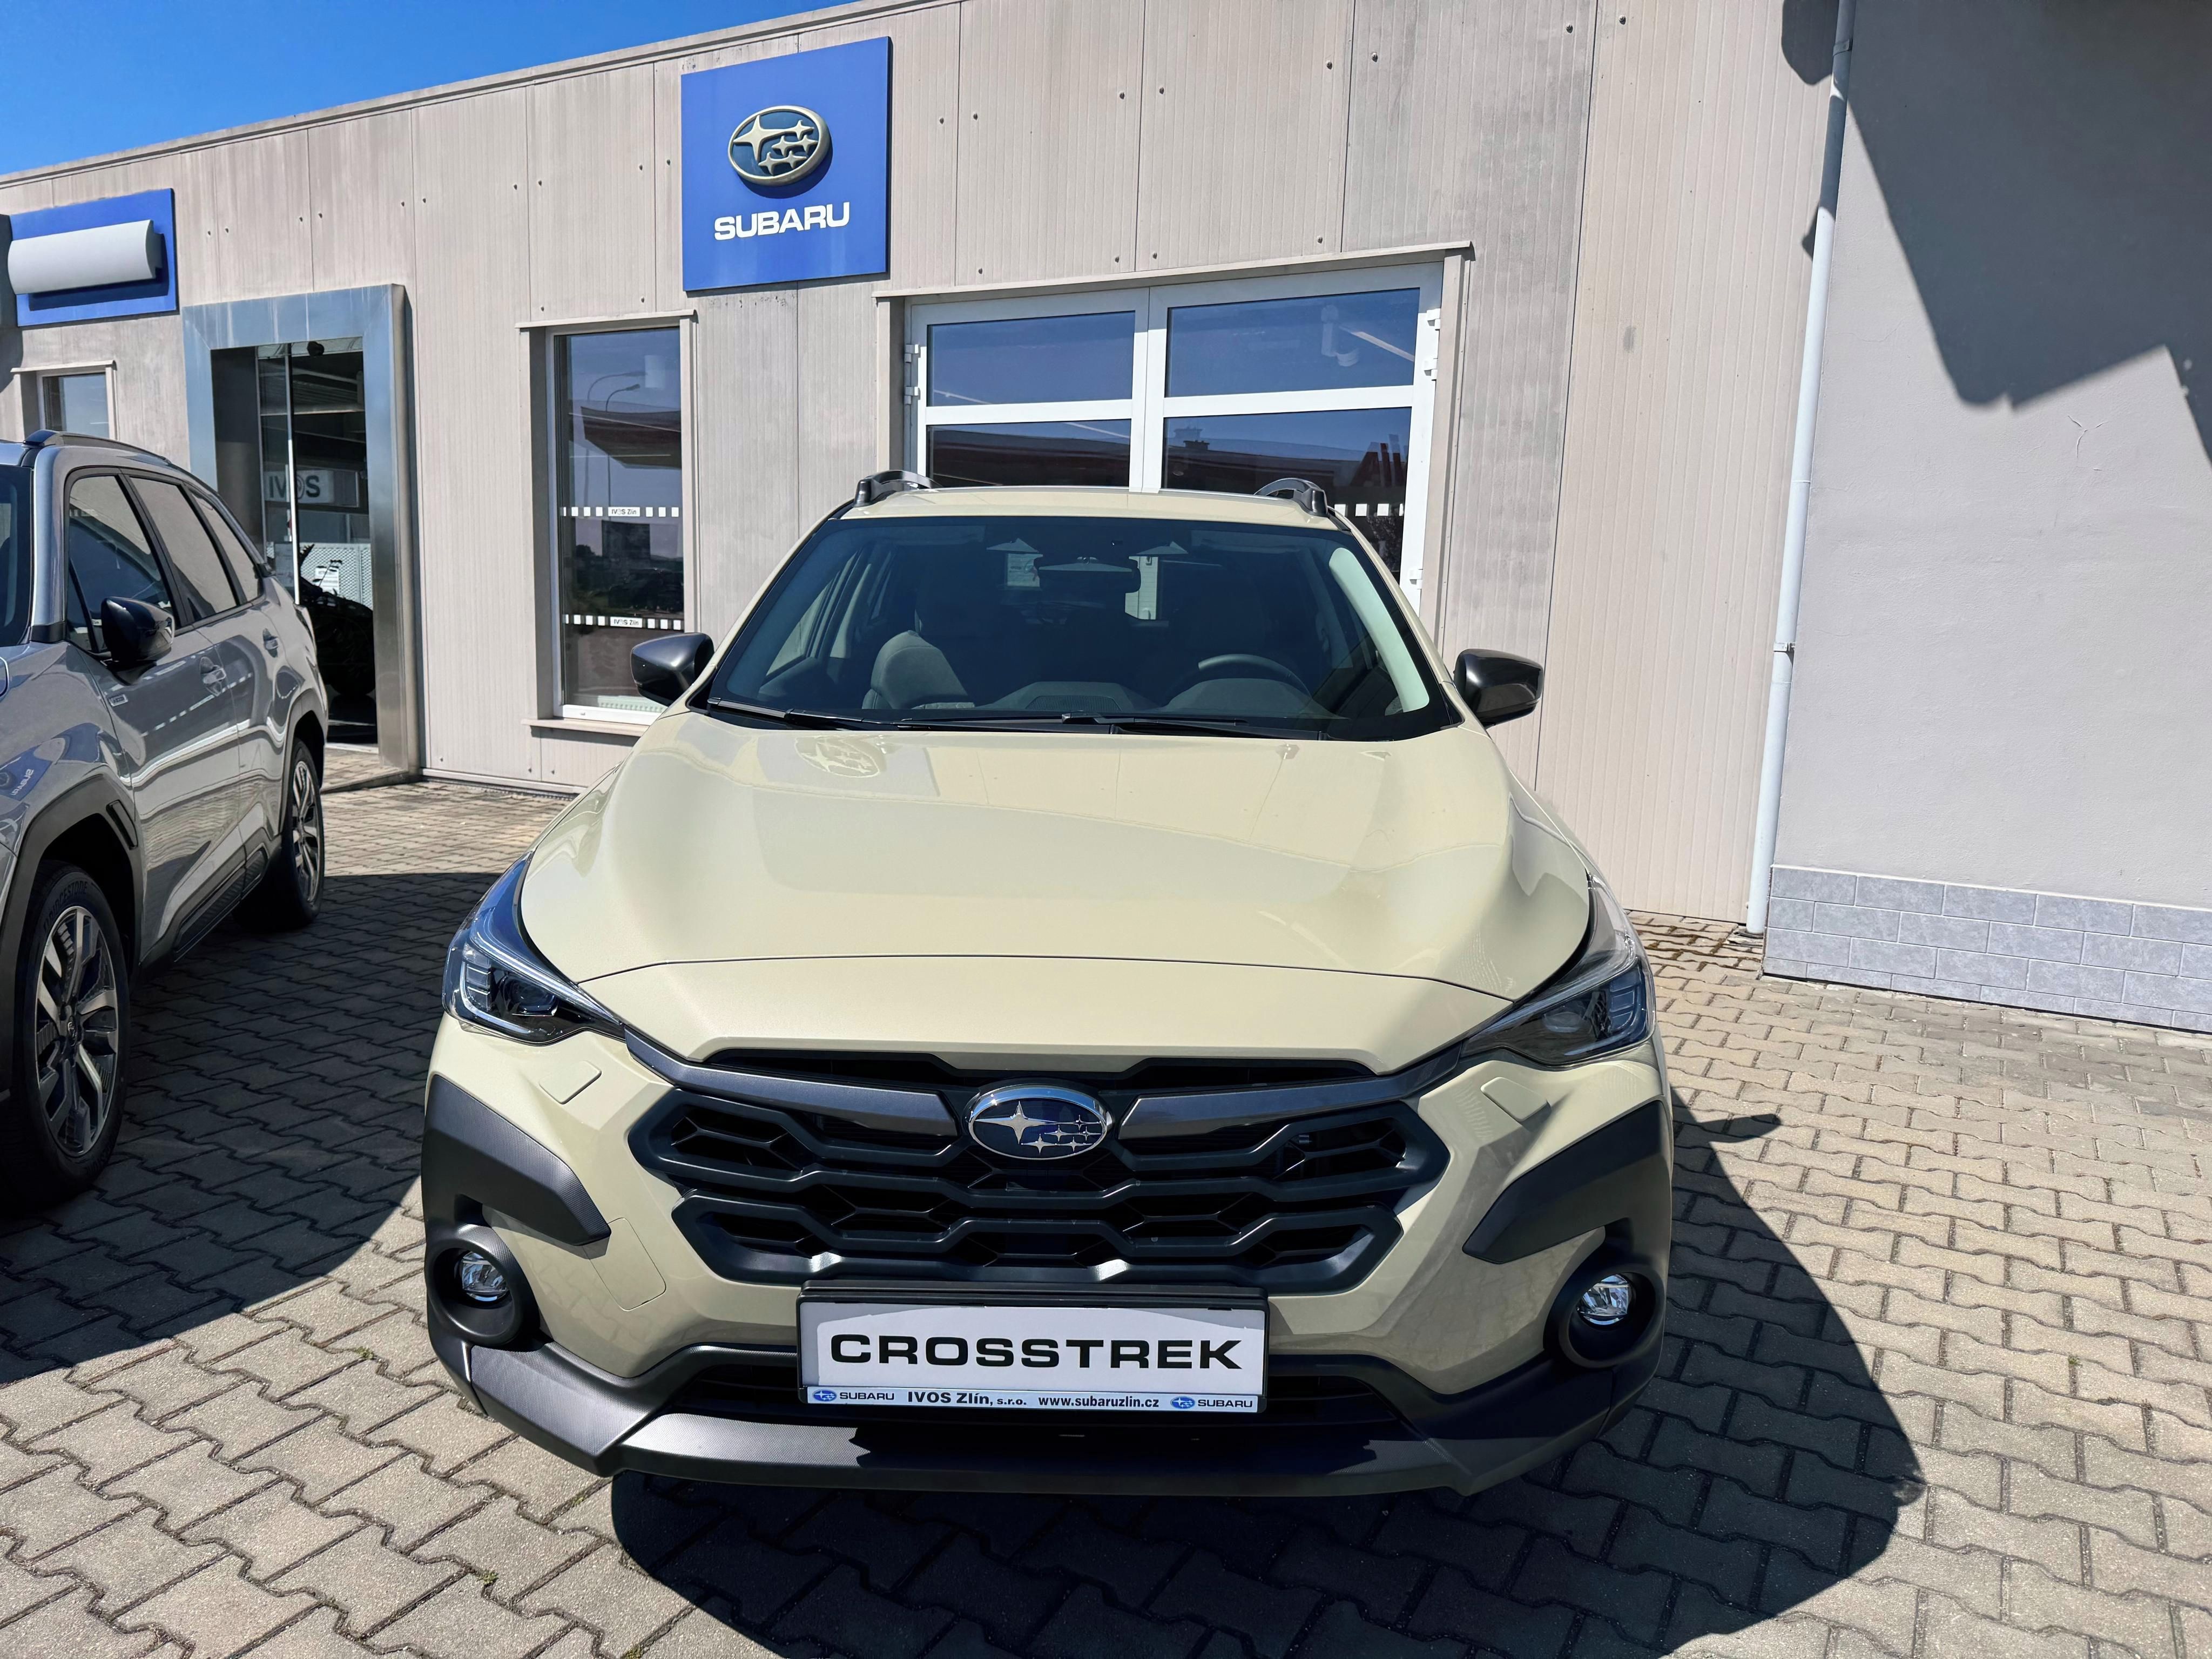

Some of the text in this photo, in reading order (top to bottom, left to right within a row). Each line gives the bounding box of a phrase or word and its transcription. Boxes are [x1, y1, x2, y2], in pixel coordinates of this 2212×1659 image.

[714, 201, 850, 241] SUBARU
[831, 1333, 1243, 1370] CROSSTREK
[839, 1391, 1253, 1408] SUBARU IVOS Zlín, s.r.o. www.subaruzlin.cz SUBARU
